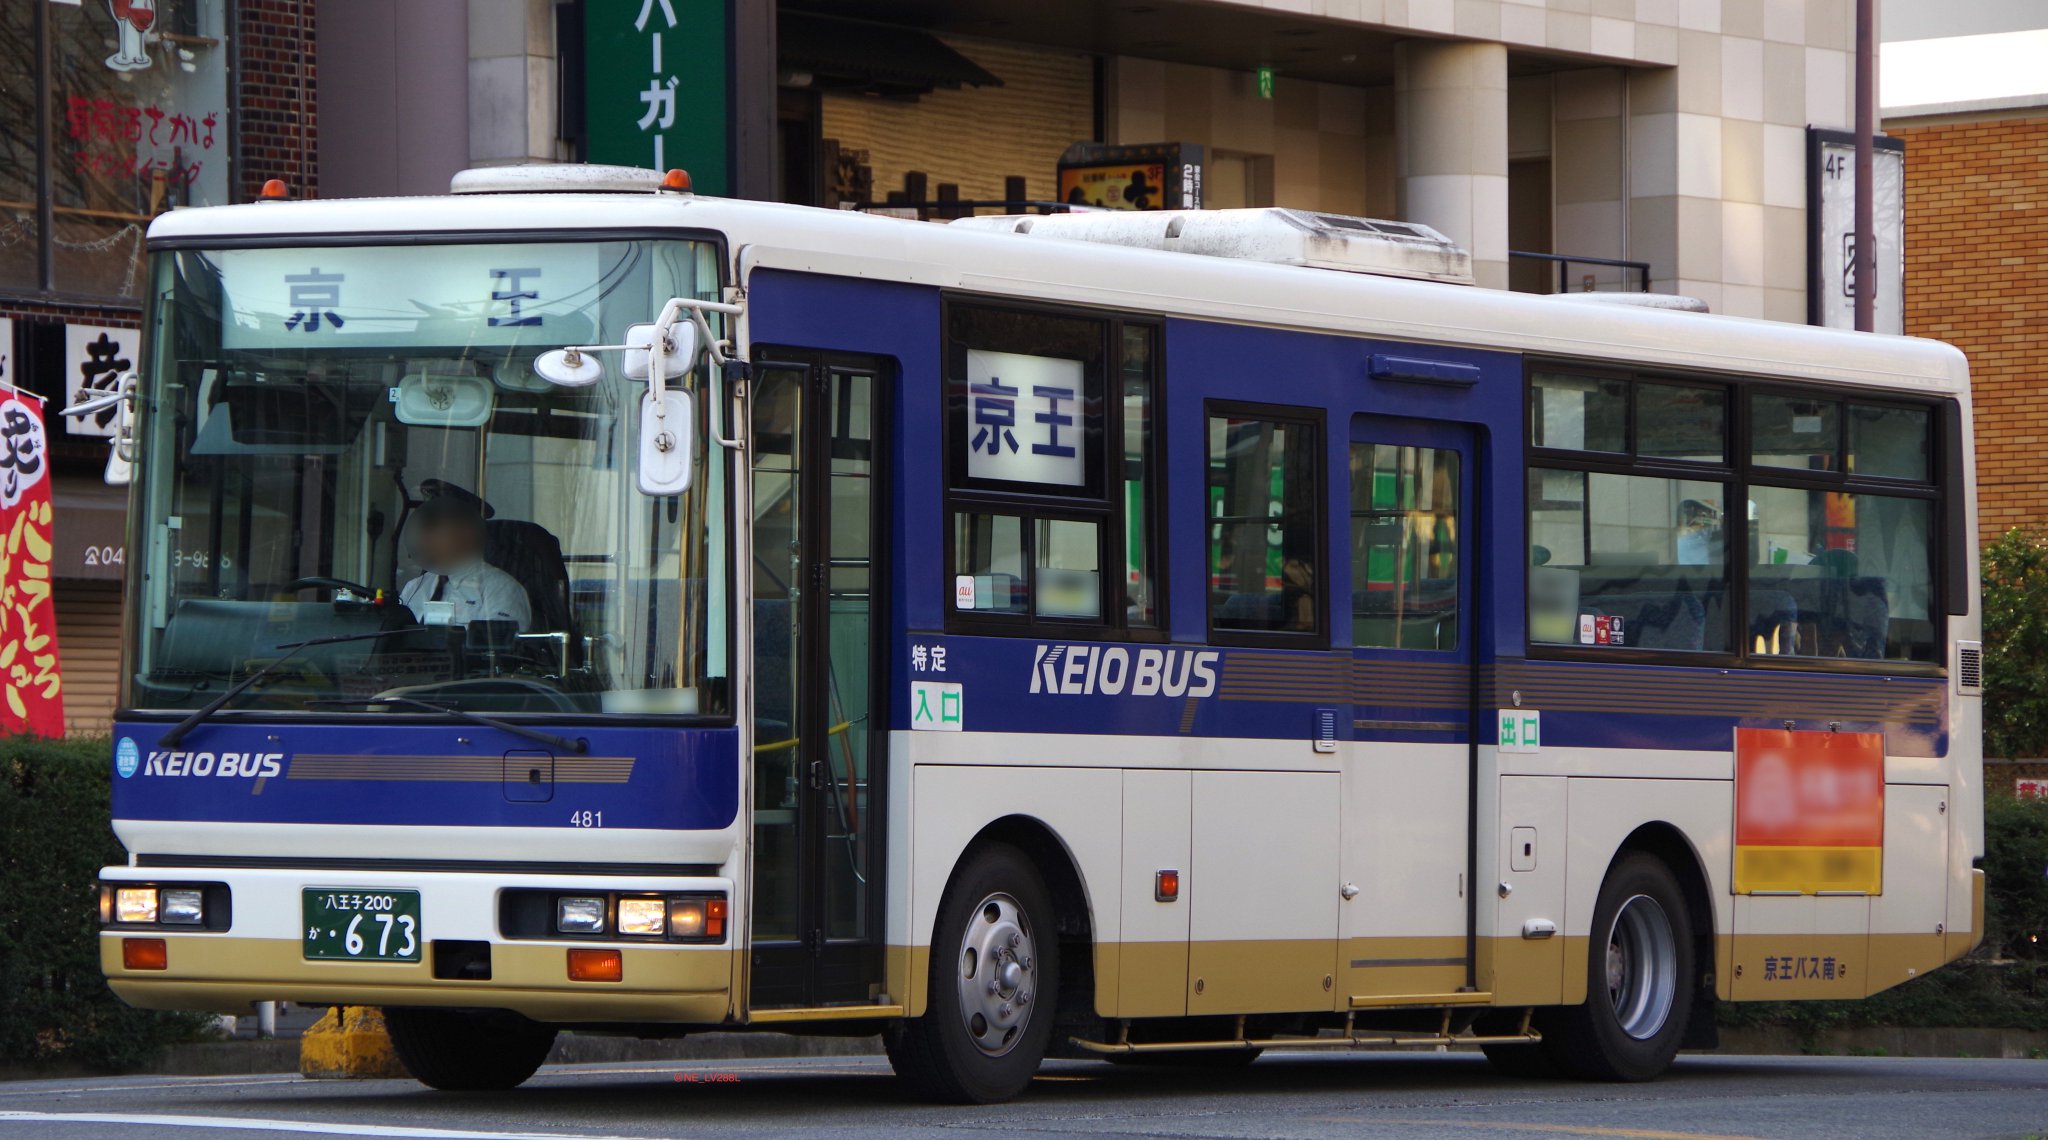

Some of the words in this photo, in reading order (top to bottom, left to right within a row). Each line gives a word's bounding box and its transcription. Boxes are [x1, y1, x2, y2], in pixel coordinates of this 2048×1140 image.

[1826, 154, 1846, 180] 4F
[284, 267, 543, 332] 京王
[970, 376, 1076, 459] 京王
[912, 645, 947, 672] 特定
[1029, 645, 1129, 695] KEIO
[1132, 649, 1220, 697] BUS
[915, 690, 960, 724] 入口
[1501, 717, 1538, 747] 出口
[144, 752, 215, 777] KEIO
[216, 753, 284, 778] BUS
[570, 811, 602, 828] 481
[325, 895, 363, 910] 八王子
[364, 896, 393, 911] 200
[309, 926, 320, 940] か
[1764, 956, 1837, 981] 京王バス南
